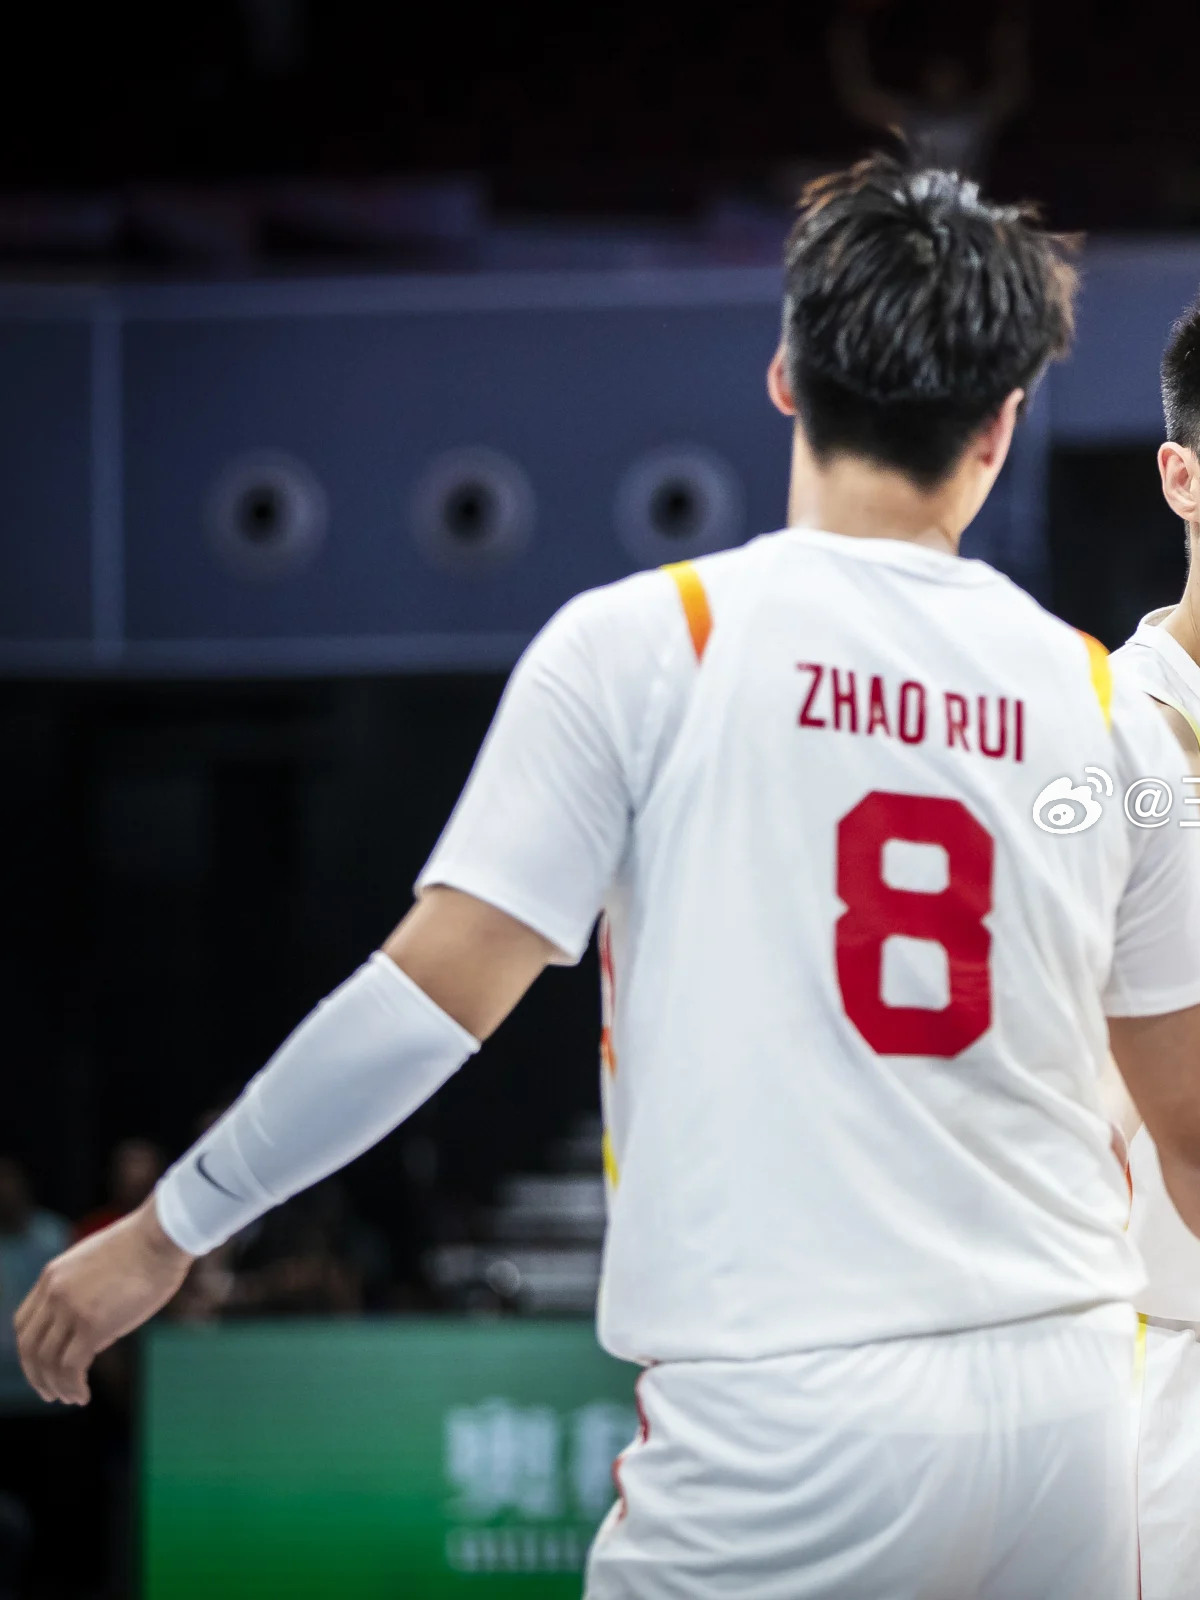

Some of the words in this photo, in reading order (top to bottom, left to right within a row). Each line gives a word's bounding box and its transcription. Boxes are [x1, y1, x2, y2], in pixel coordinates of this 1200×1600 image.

[797, 662, 927, 746] ZHAO
[944, 692, 1025, 763] RUI
[834, 789, 995, 1060] 8
